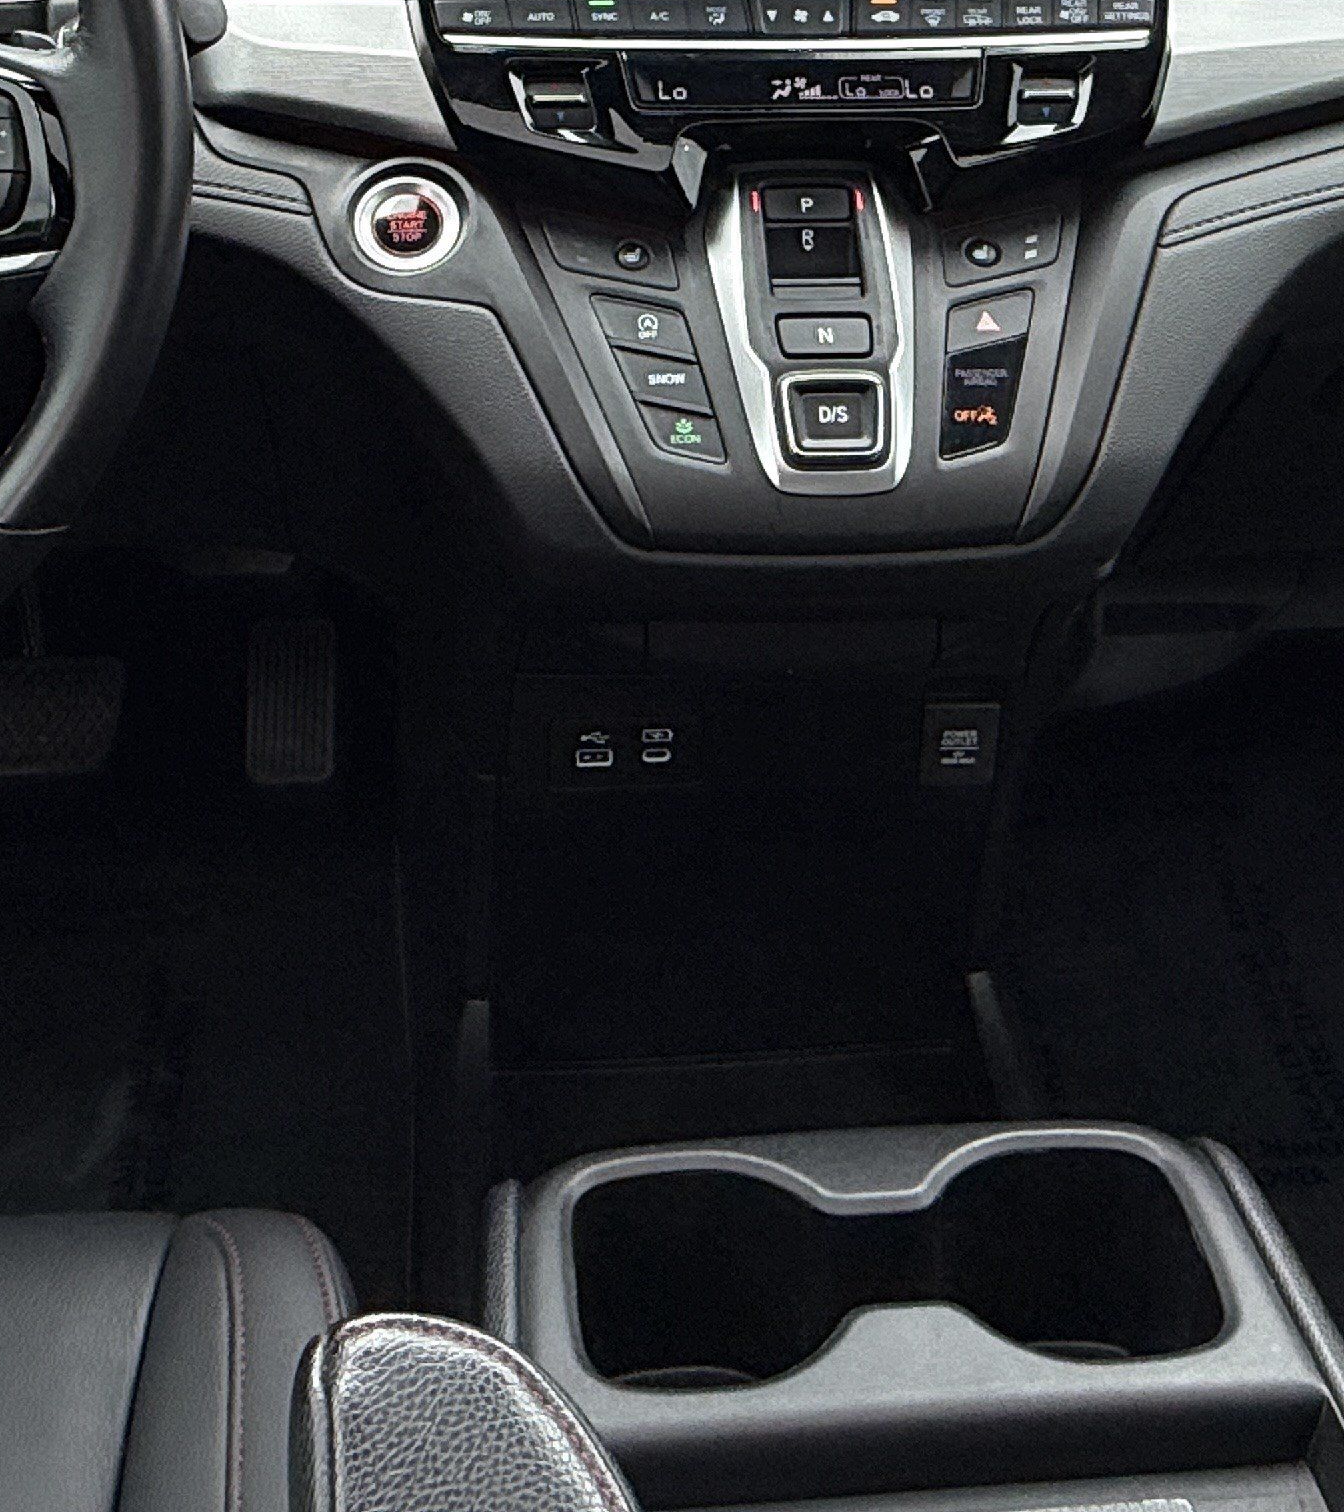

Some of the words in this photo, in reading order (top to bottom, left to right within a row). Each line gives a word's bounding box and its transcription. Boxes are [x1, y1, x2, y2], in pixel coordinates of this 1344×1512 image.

[526, 11, 556, 23] AUTO
[590, 11, 619, 23] SYNC
[800, 197, 814, 214] P
[389, 219, 425, 230] START
[817, 326, 834, 344] N
[647, 372, 686, 386] SNOW
[817, 405, 850, 424] D/S
[953, 408, 977, 422] OFF
[669, 432, 703, 444] ECON
